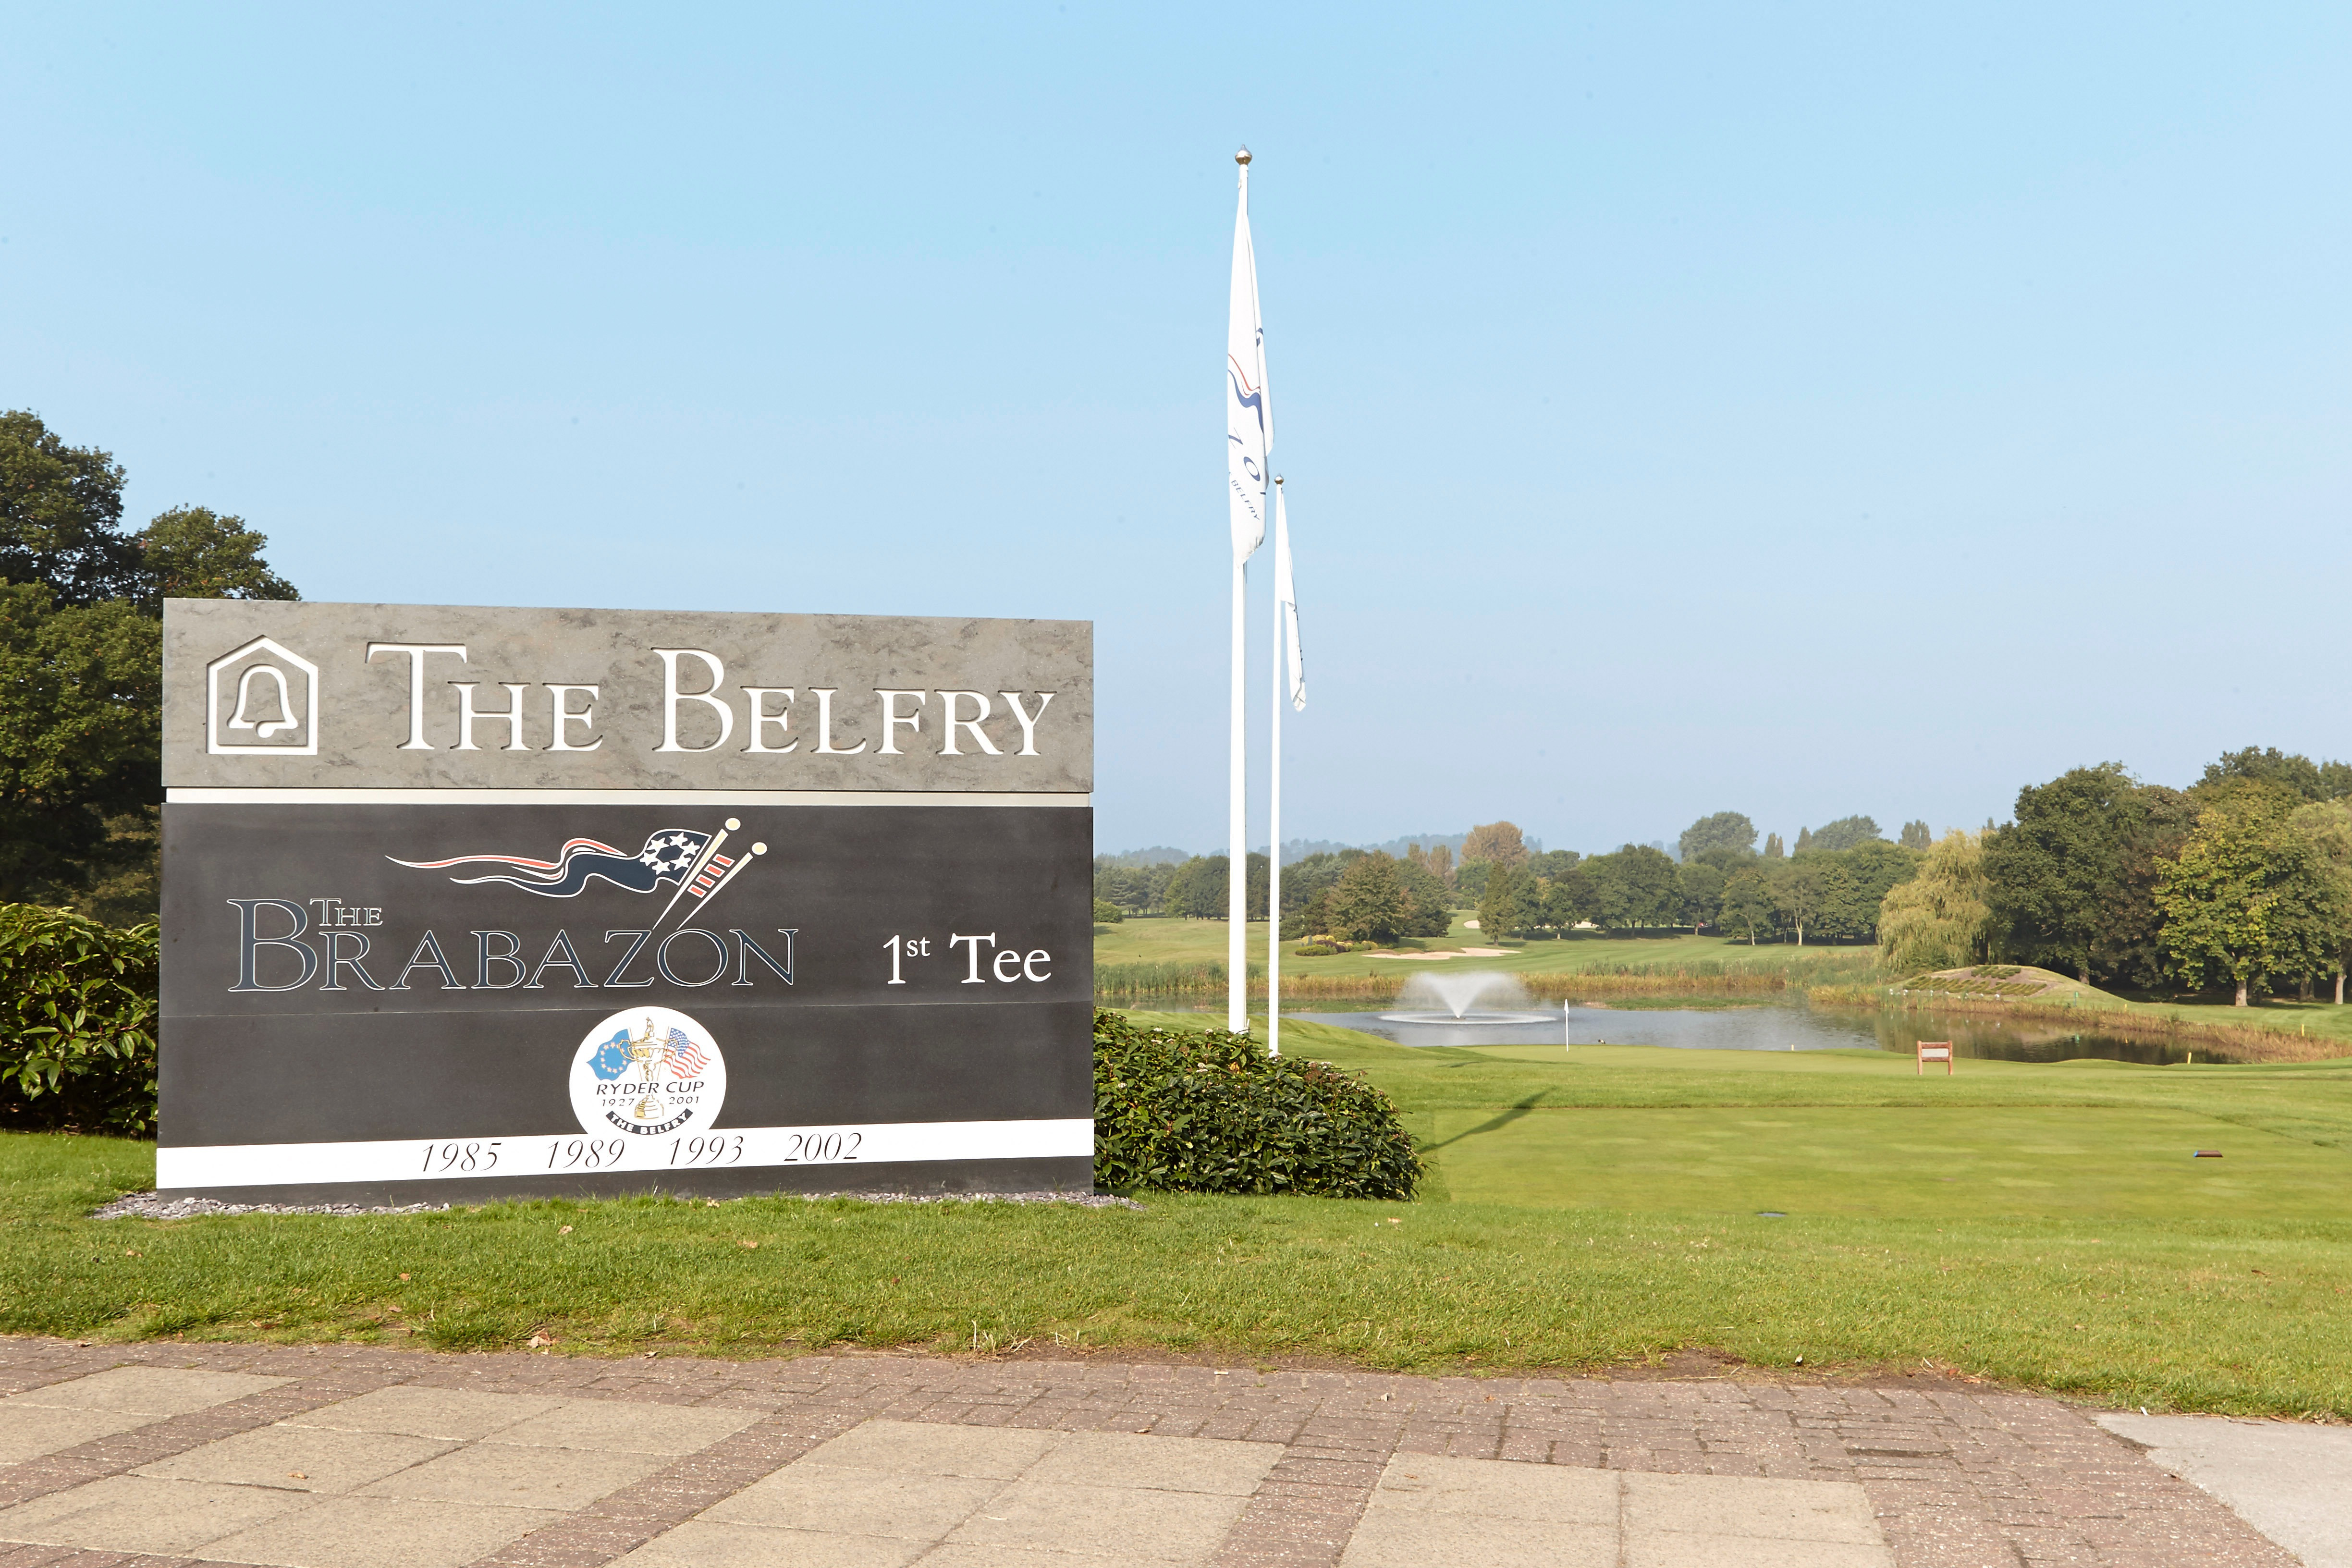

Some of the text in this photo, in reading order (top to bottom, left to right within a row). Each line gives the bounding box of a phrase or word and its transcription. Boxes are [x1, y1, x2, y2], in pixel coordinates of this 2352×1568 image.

[366, 642, 1057, 757] THE BELFRY
[310, 897, 383, 927] THE
[227, 898, 798, 992] BRABAZON
[883, 932, 1051, 984] 1st Tee
[596, 1081, 704, 1095] RYDER CUP
[602, 1096, 699, 1107] 1927 2001
[610, 1112, 688, 1134] THE BELFRY
[421, 1132, 862, 1173] 1985 1989 1993 2002
